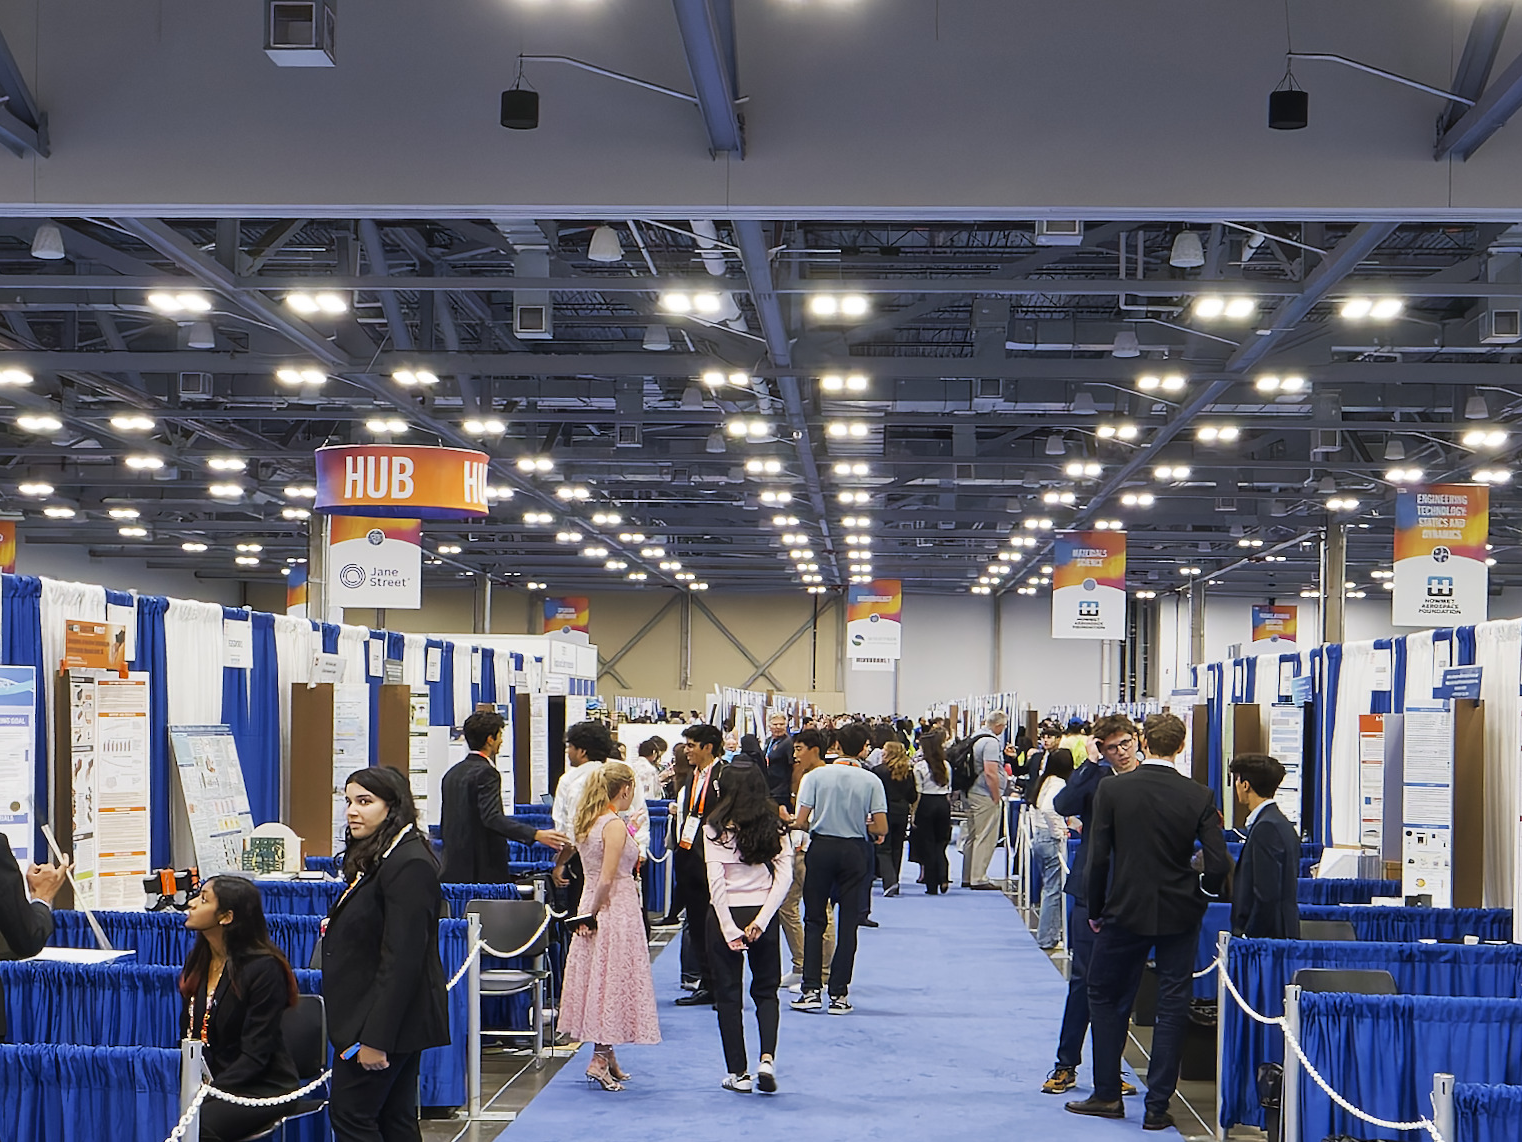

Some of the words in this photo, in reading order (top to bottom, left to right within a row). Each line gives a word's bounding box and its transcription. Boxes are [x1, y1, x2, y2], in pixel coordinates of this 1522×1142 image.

[344, 455, 415, 499] HUB
[1416, 493, 1468, 505] ENGINEERING
[1450, 518, 1466, 528] AND
[370, 567, 399, 577] Jane
[370, 577, 406, 587] Street
